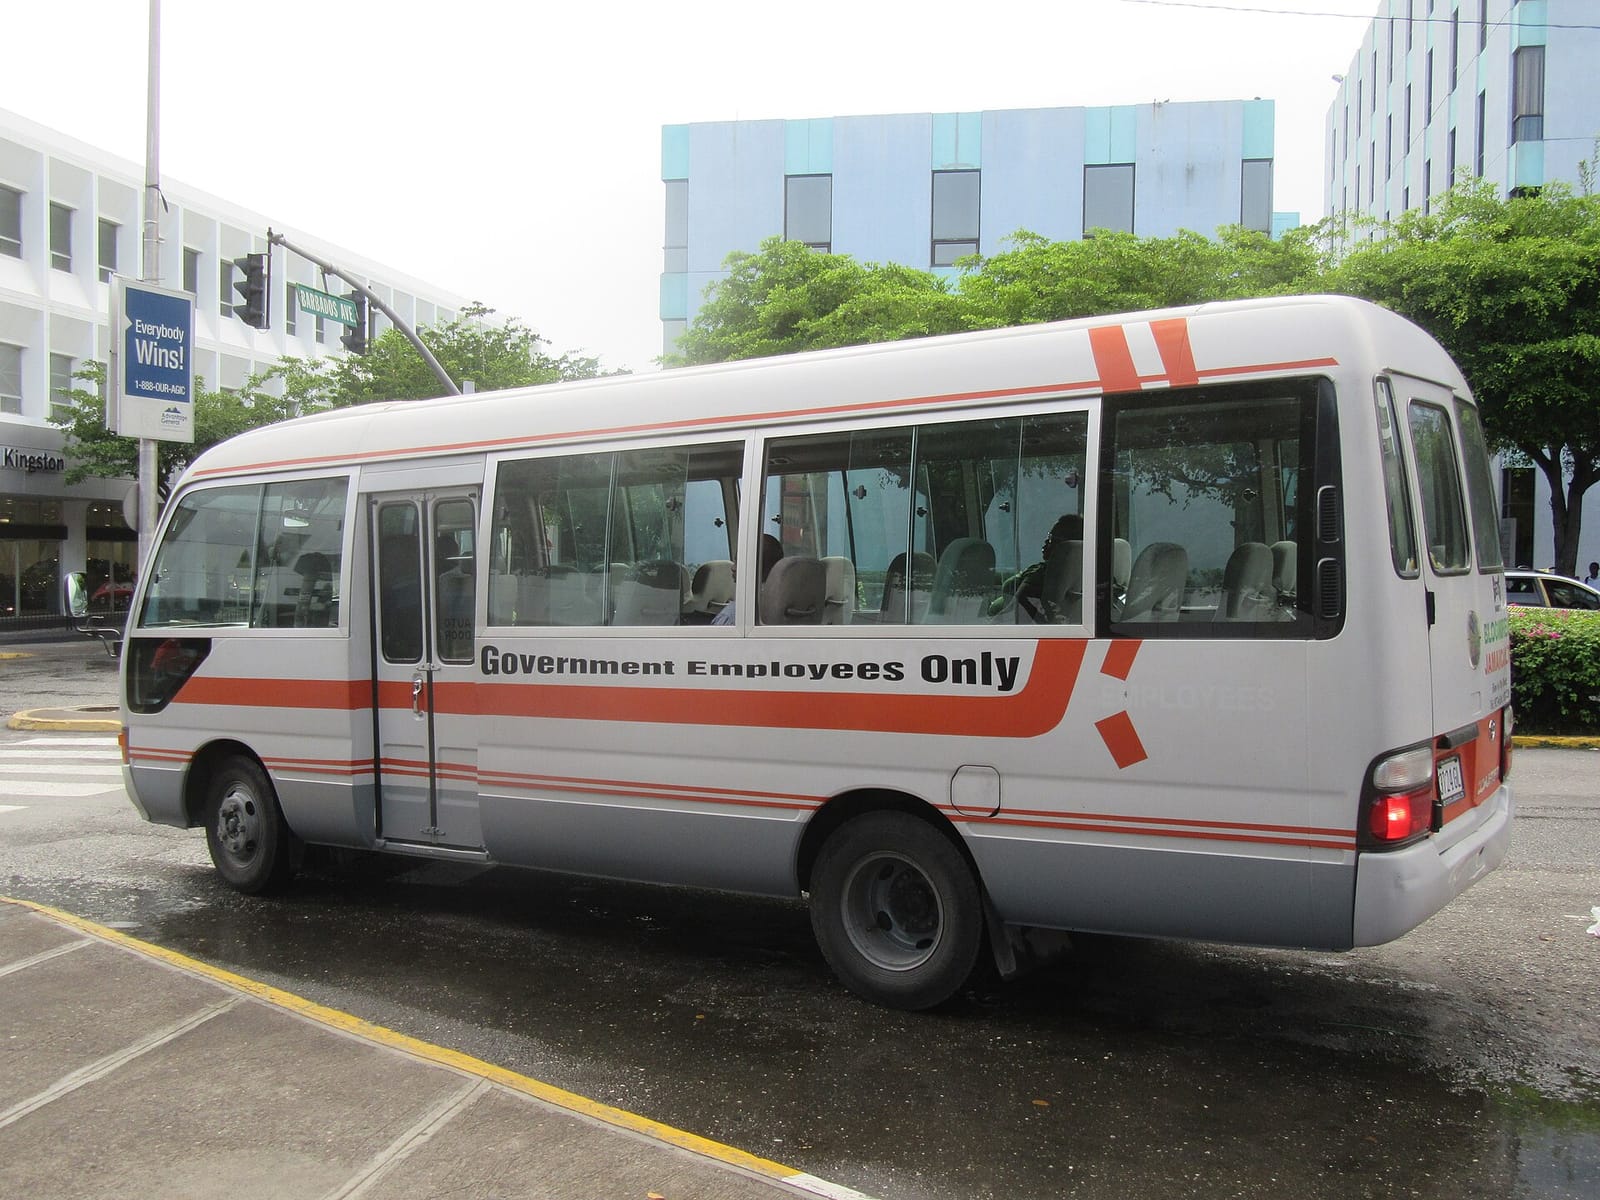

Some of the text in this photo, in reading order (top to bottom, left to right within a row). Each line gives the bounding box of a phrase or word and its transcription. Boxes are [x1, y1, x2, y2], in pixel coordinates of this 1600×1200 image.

[300, 290, 357, 323] BARBADOS AVE.
[135, 319, 184, 343] Everybody
[135, 338, 184, 370] Wins!
[135, 380, 186, 395] 1-888-OUR-AGIC
[4, 447, 64, 473] Kingston
[481, 645, 1020, 691] Government Employees Only
